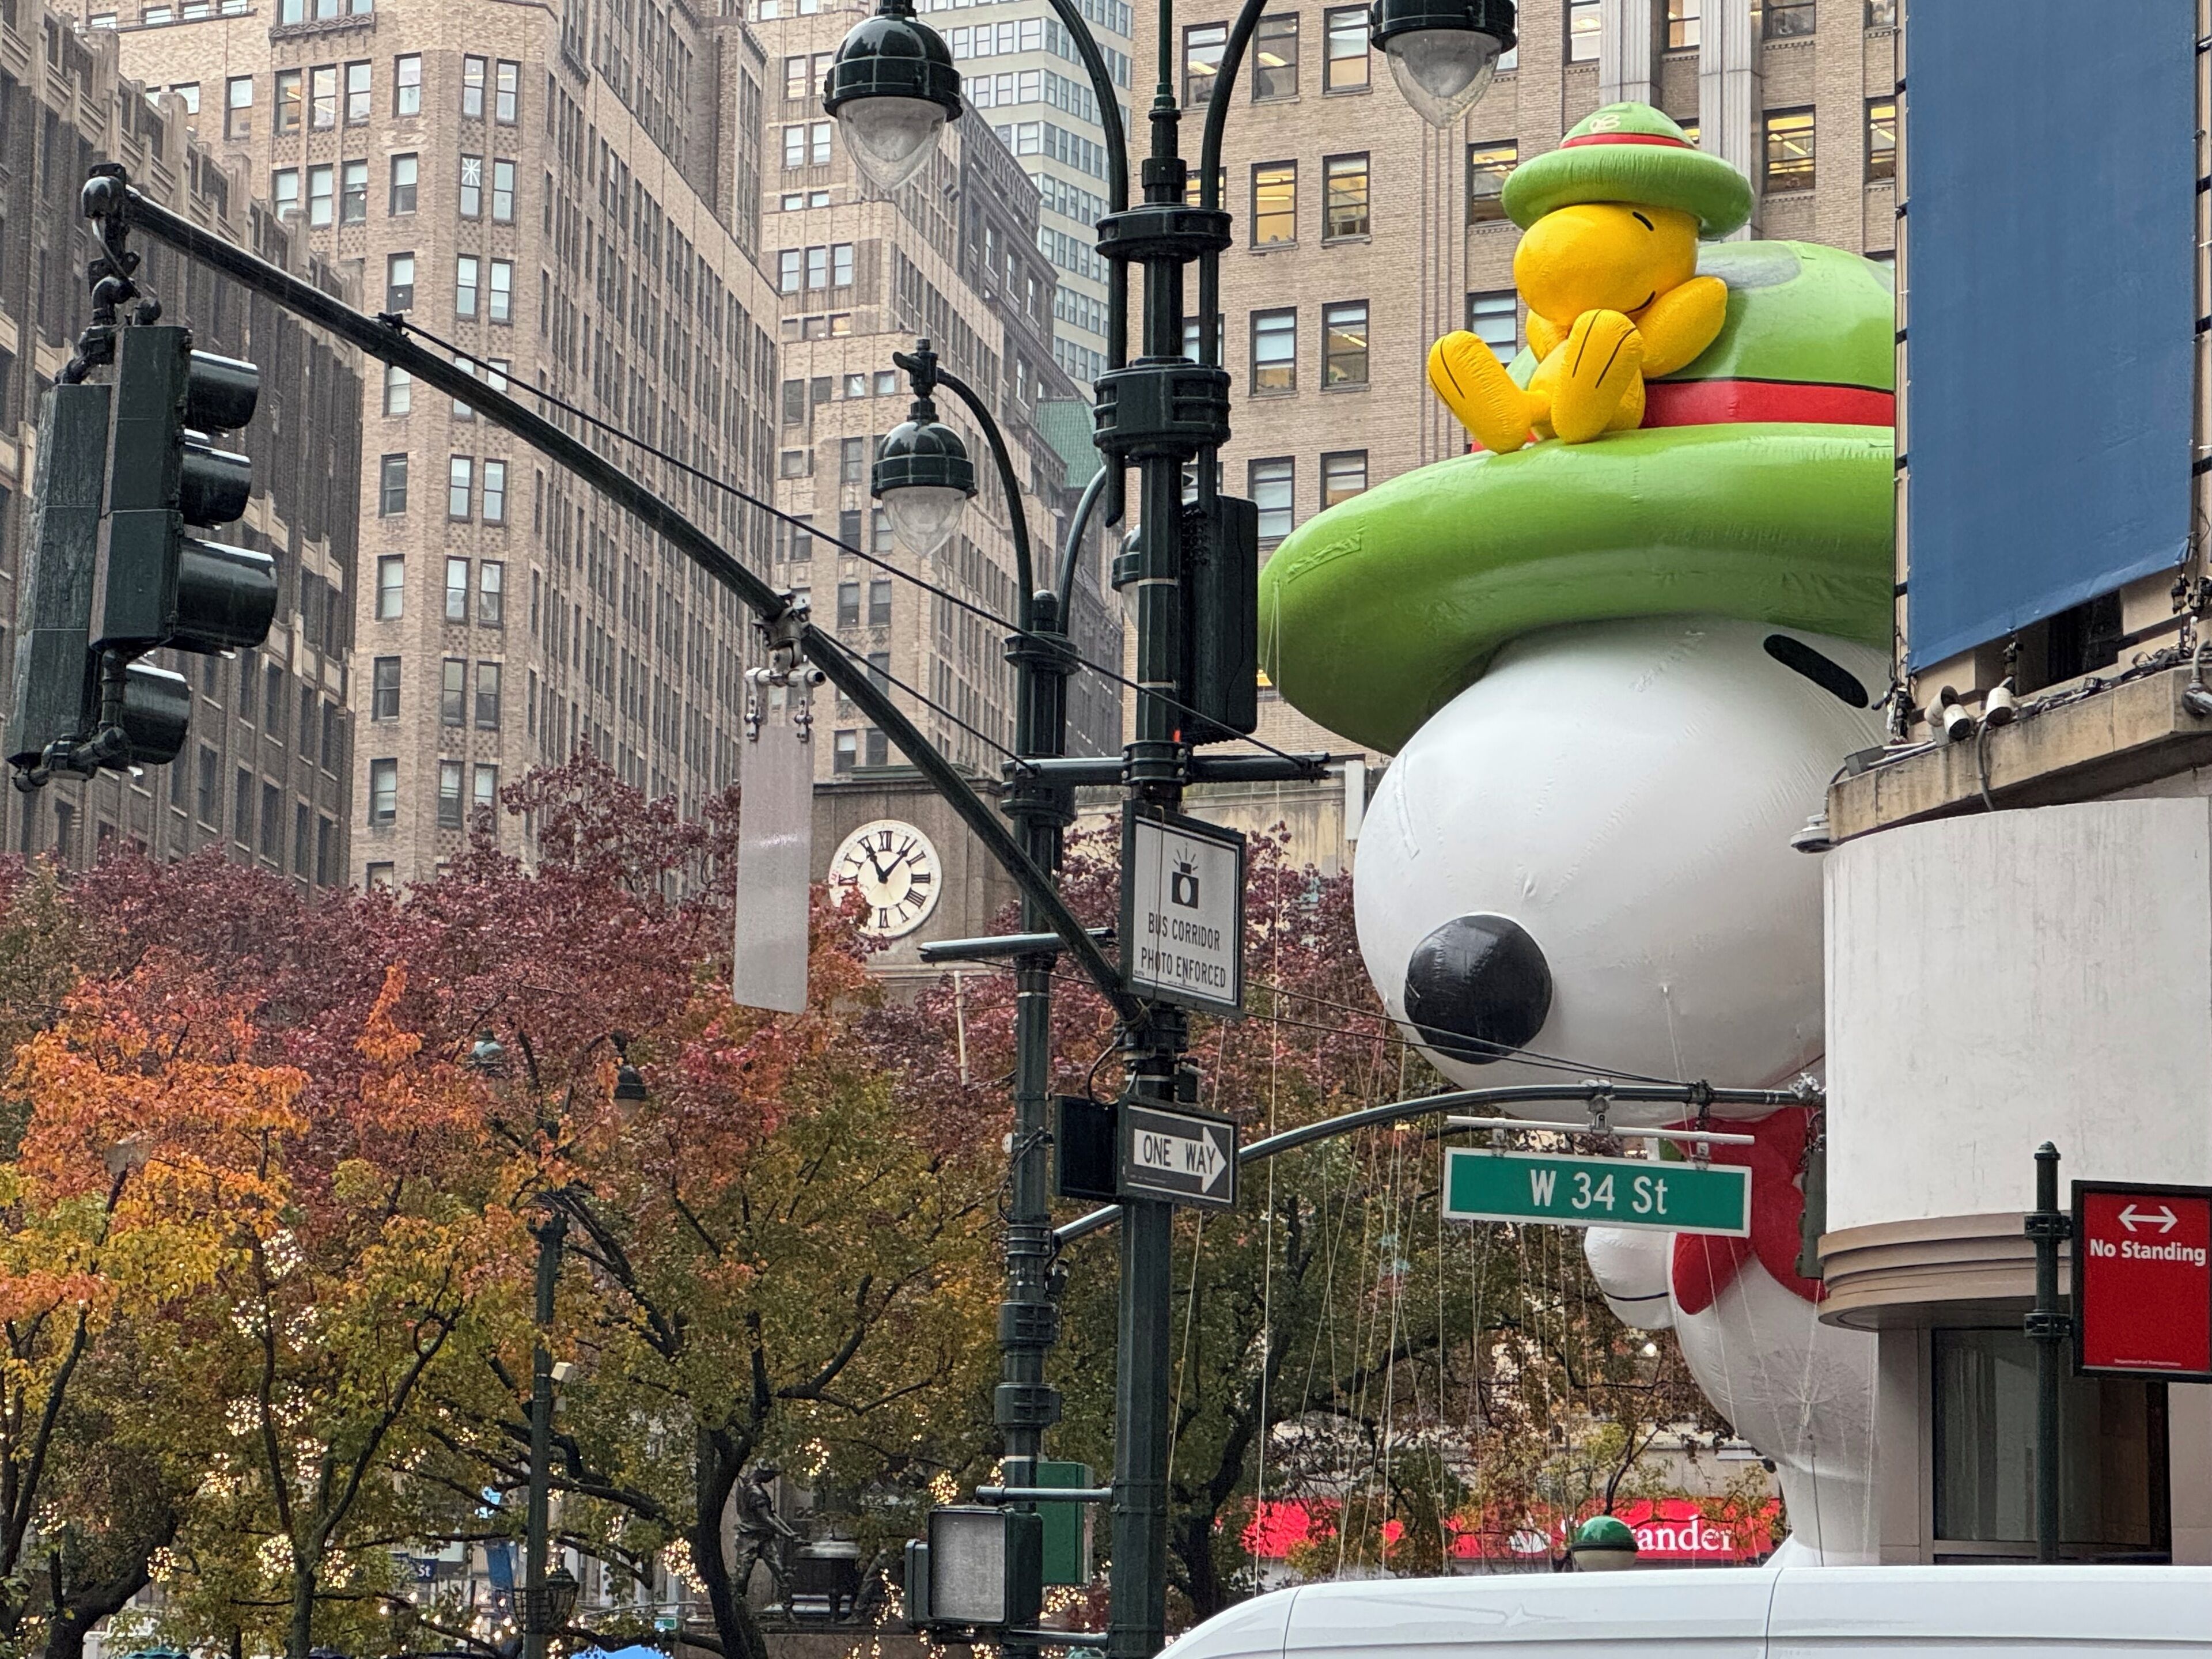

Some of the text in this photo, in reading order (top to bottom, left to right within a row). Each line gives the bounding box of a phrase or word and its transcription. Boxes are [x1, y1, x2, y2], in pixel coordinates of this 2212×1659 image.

[878, 830, 893, 852] XII
[1148, 912, 1220, 951] BUS CORRIDOR
[1141, 947, 1226, 988] PHOTO ENFORCED
[1143, 1135, 1216, 1175] ONE WAY
[1530, 1169, 1668, 1215] W 34 St
[2090, 1239, 2206, 1267] No Standing
[418, 1565, 431, 1577] St
